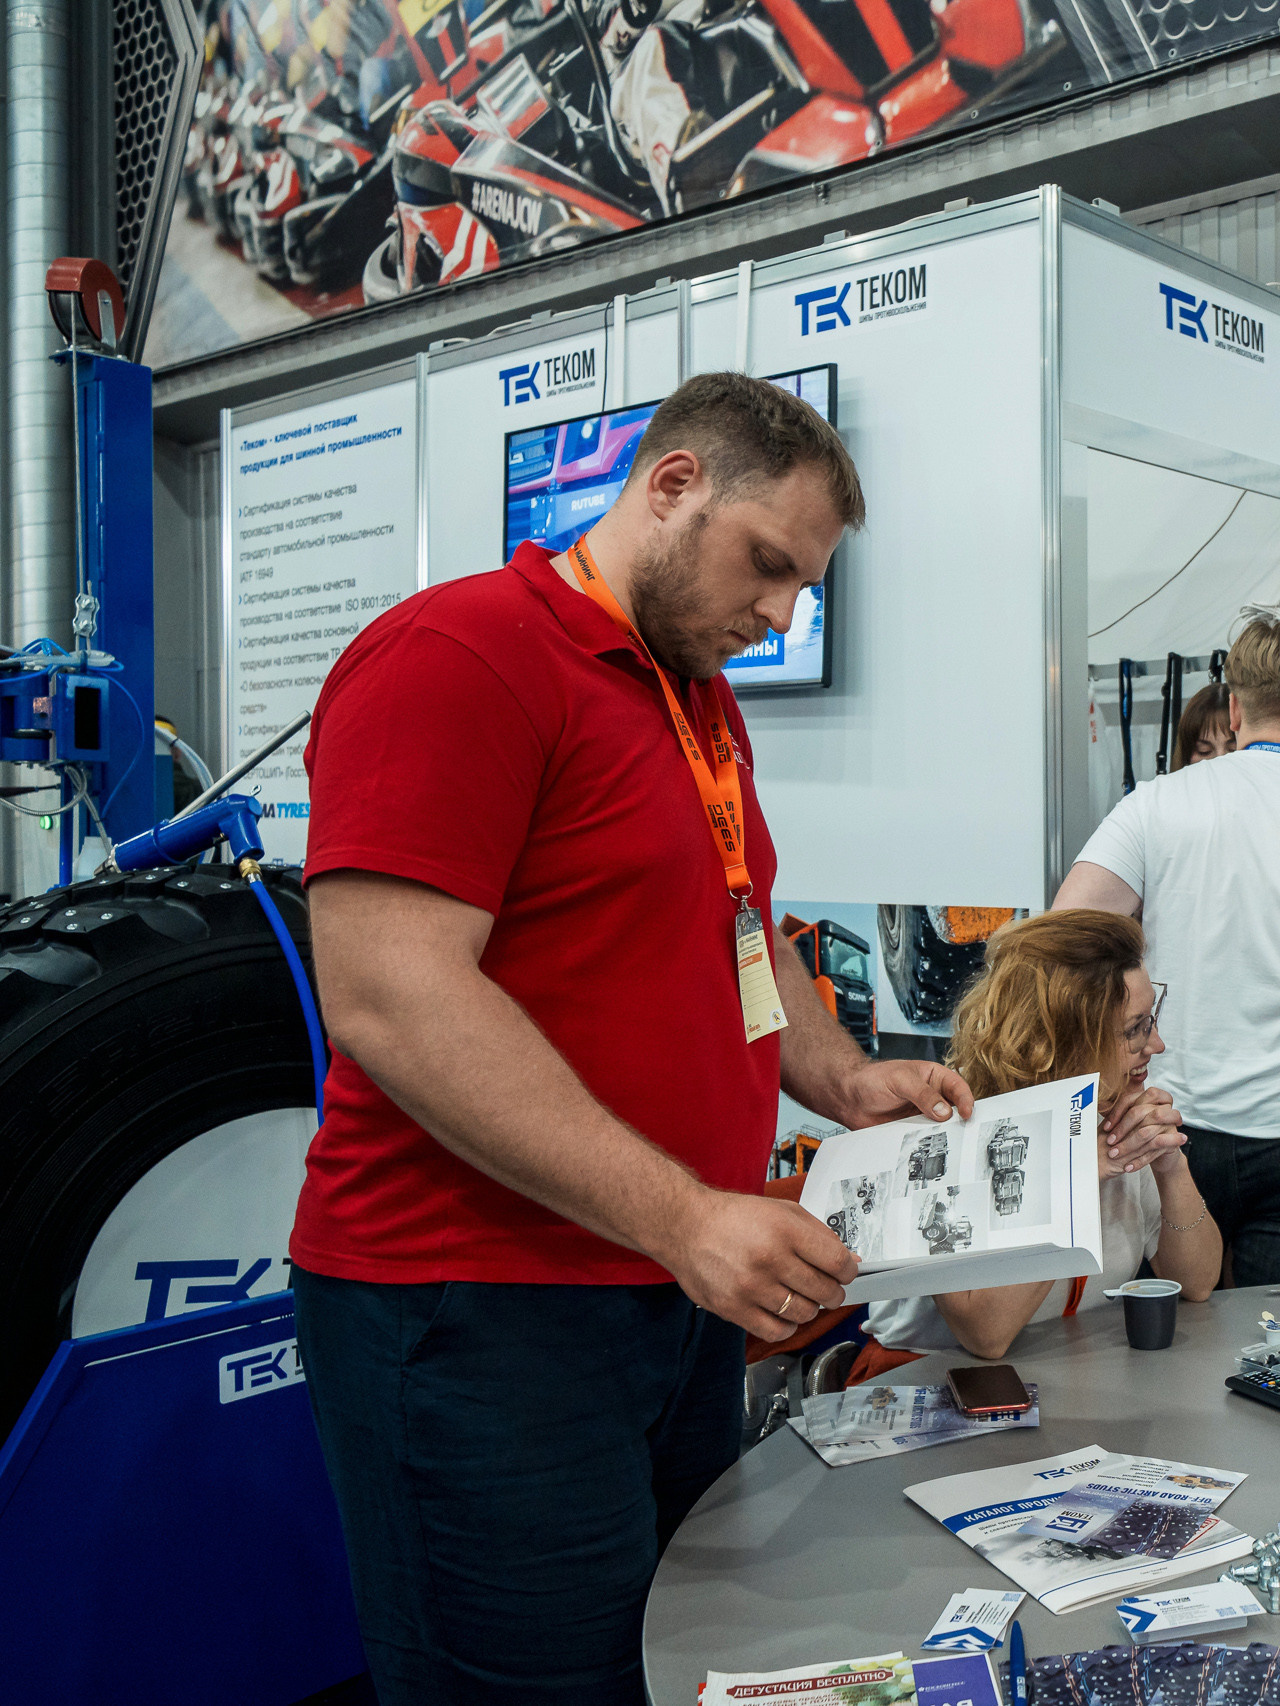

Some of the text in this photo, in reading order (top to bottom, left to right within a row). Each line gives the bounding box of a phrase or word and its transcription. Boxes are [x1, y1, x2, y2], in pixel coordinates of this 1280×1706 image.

[471, 181, 543, 236] #ARENAJCW
[856, 264, 927, 312] ТЕКОМ
[1211, 303, 1264, 354] ТЕКОМ
[544, 348, 596, 387] ТЕКОМ
[239, 413, 358, 452] «Теком» ключевой поставщик
[239, 426, 403, 476] продукции для шинной промышленности
[571, 493, 606, 511] RUTUBE
[345, 597, 359, 612] ISO
[360, 592, 401, 611] 9001:2015
[1069, 1112, 1082, 1137] ТЕКОМ
[1069, 1458, 1101, 1471] ТЕКОМ
[1086, 1482, 1121, 1493] STUDS
[1121, 1487, 1160, 1497] ARCTIC
[1160, 1491, 1213, 1504] OFF-ROAD
[964, 1504, 1015, 1523] КАТАЛОГ
[734, 1670, 887, 1698] ДЕГУСТАЦИЯ БЕСПЛАТНО
